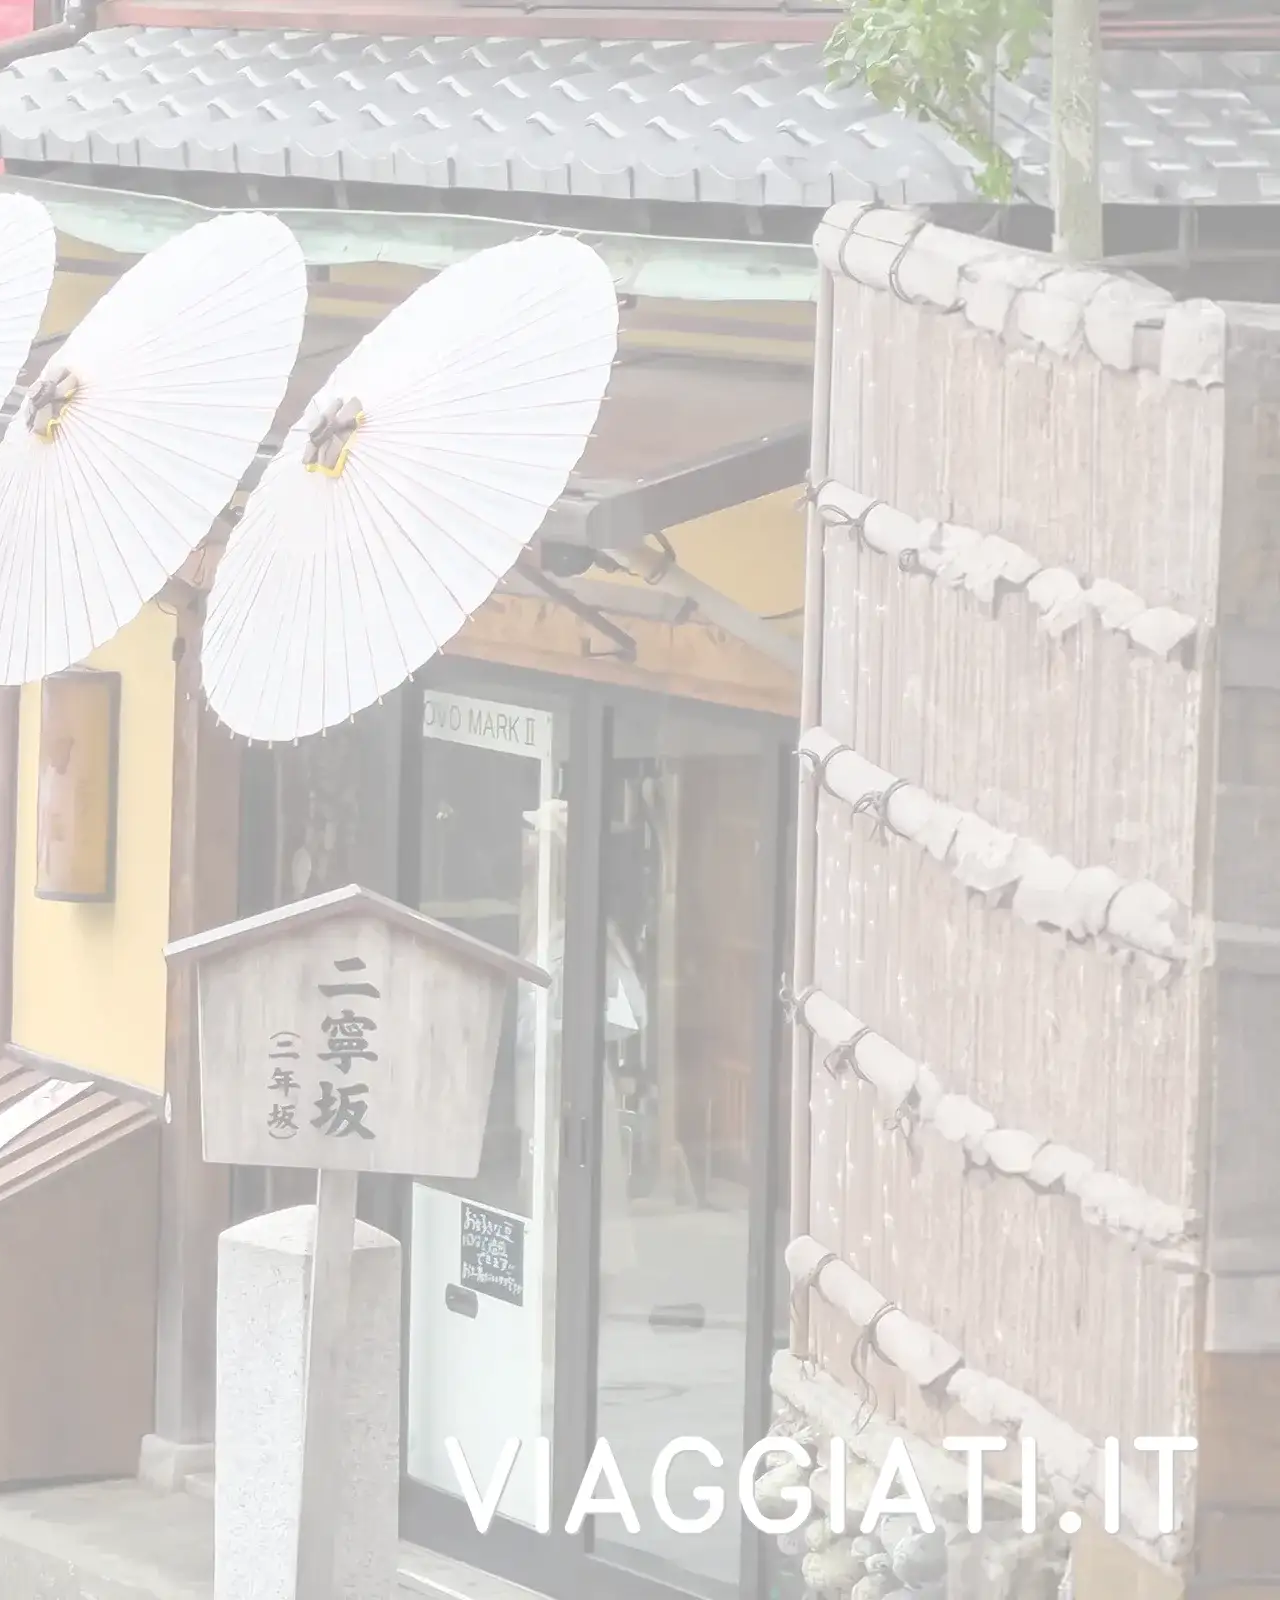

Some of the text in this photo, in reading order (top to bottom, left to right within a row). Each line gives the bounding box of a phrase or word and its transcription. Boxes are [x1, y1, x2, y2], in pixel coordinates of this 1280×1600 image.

[468, 707, 520, 744] MARK
[309, 956, 382, 1140] 二寧坂
